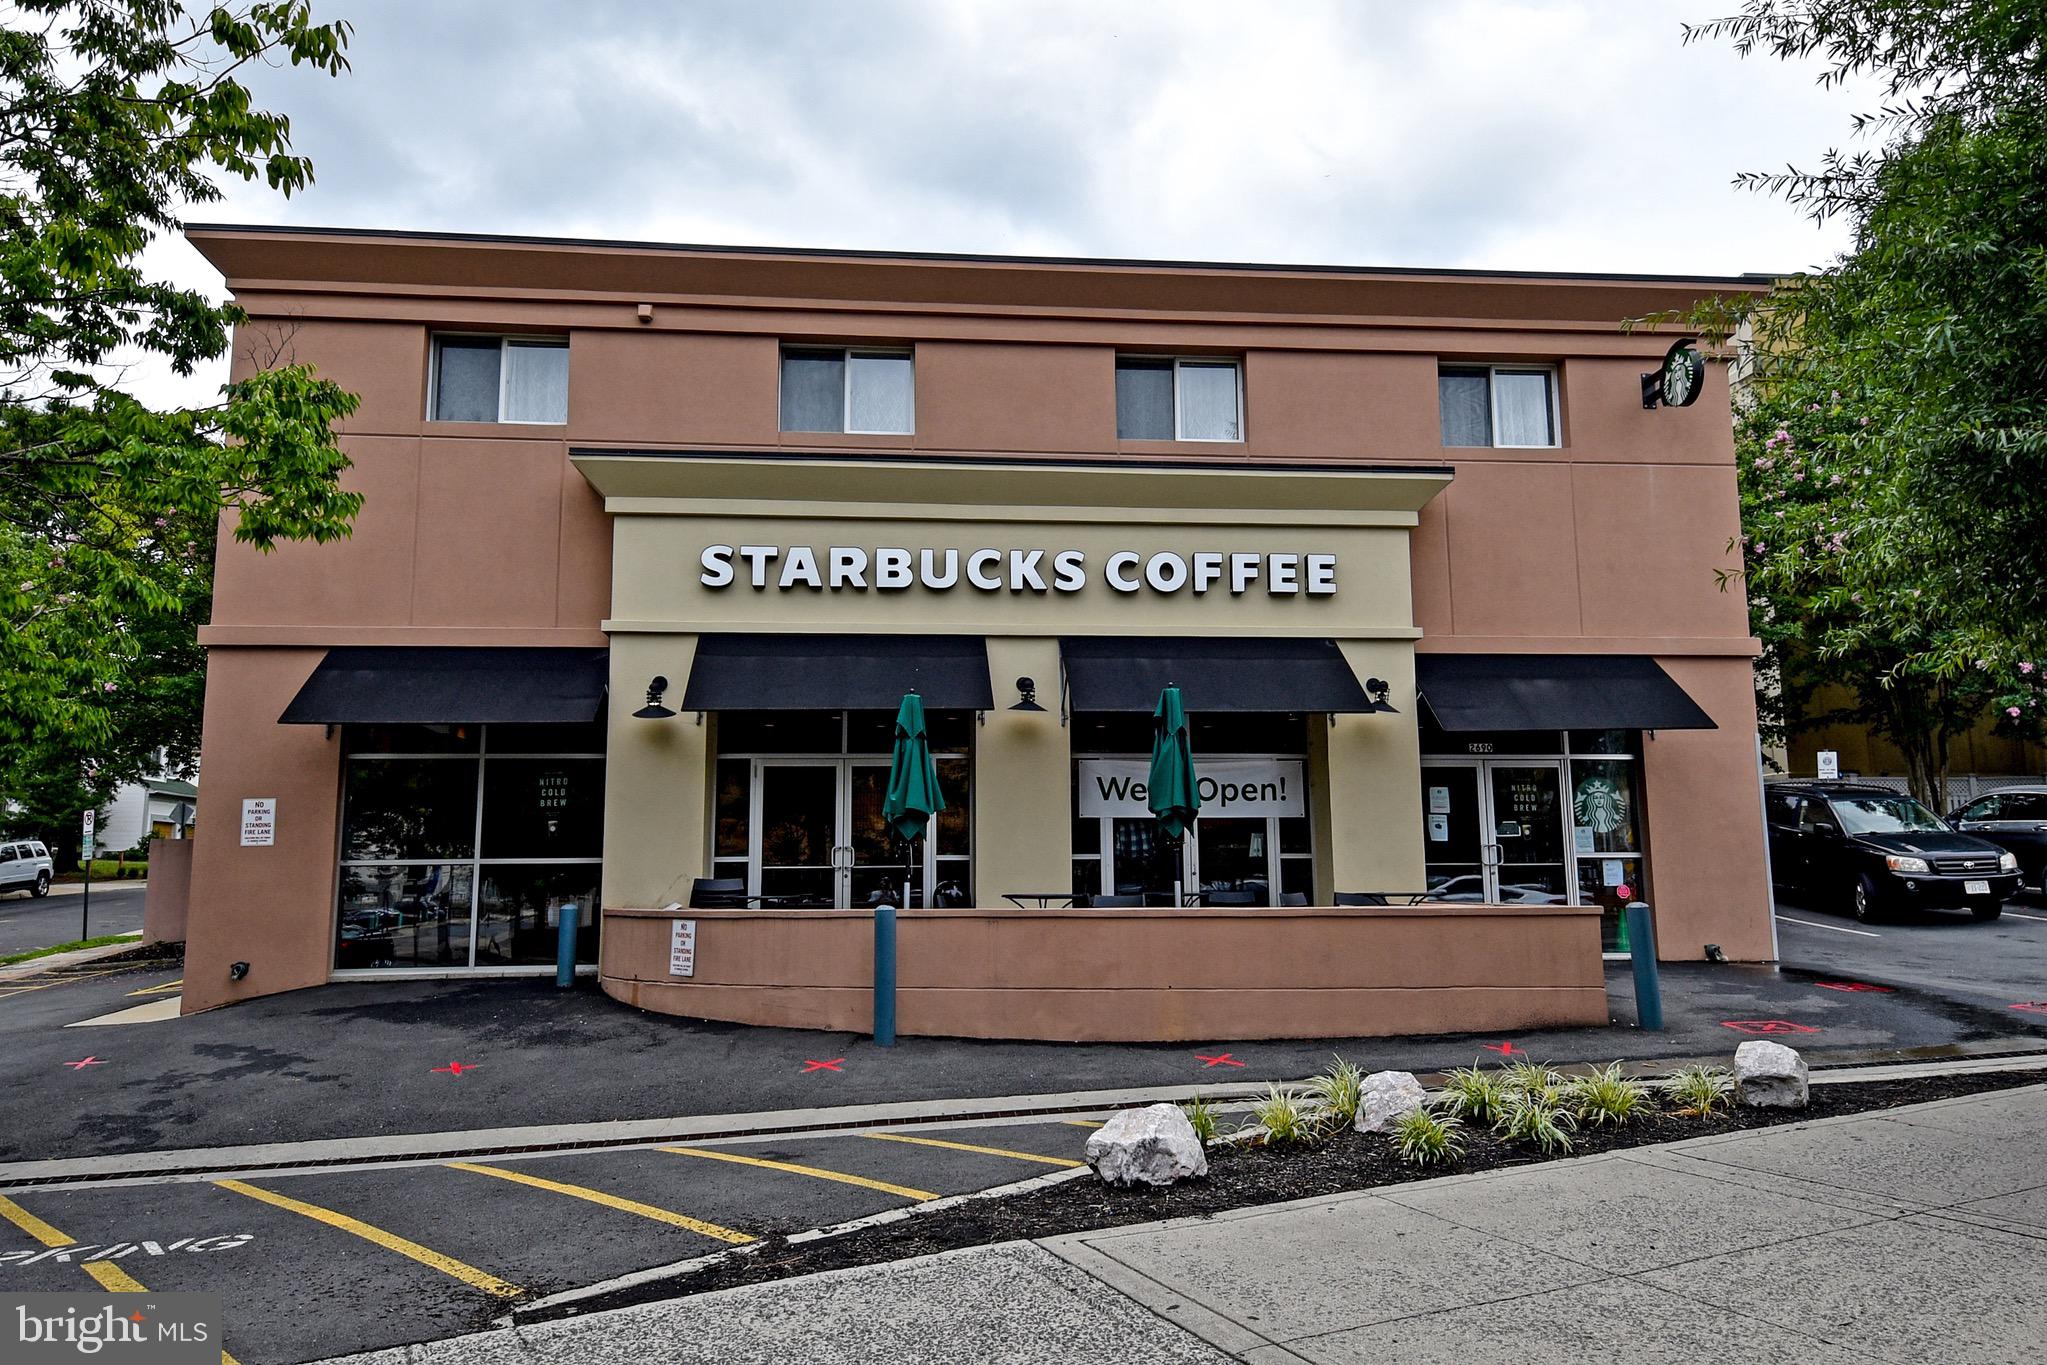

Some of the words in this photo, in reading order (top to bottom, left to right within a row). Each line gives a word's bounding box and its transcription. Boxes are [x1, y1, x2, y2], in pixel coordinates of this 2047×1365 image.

[700, 544, 1087, 593] STARBUCKS
[1104, 550, 1338, 596] COFFEE
[1469, 743, 1493, 753] 2690
[539, 777, 569, 786] NITRO
[1197, 776, 1287, 808] Open!
[1511, 784, 1537, 792] NITRO
[541, 788, 566, 797] COLD
[1513, 794, 1536, 802] COLD
[540, 799, 567, 807] BREW
[1513, 804, 1537, 812] BREW
[680, 923, 688, 931] NO
[673, 947, 692, 955] STANDING
